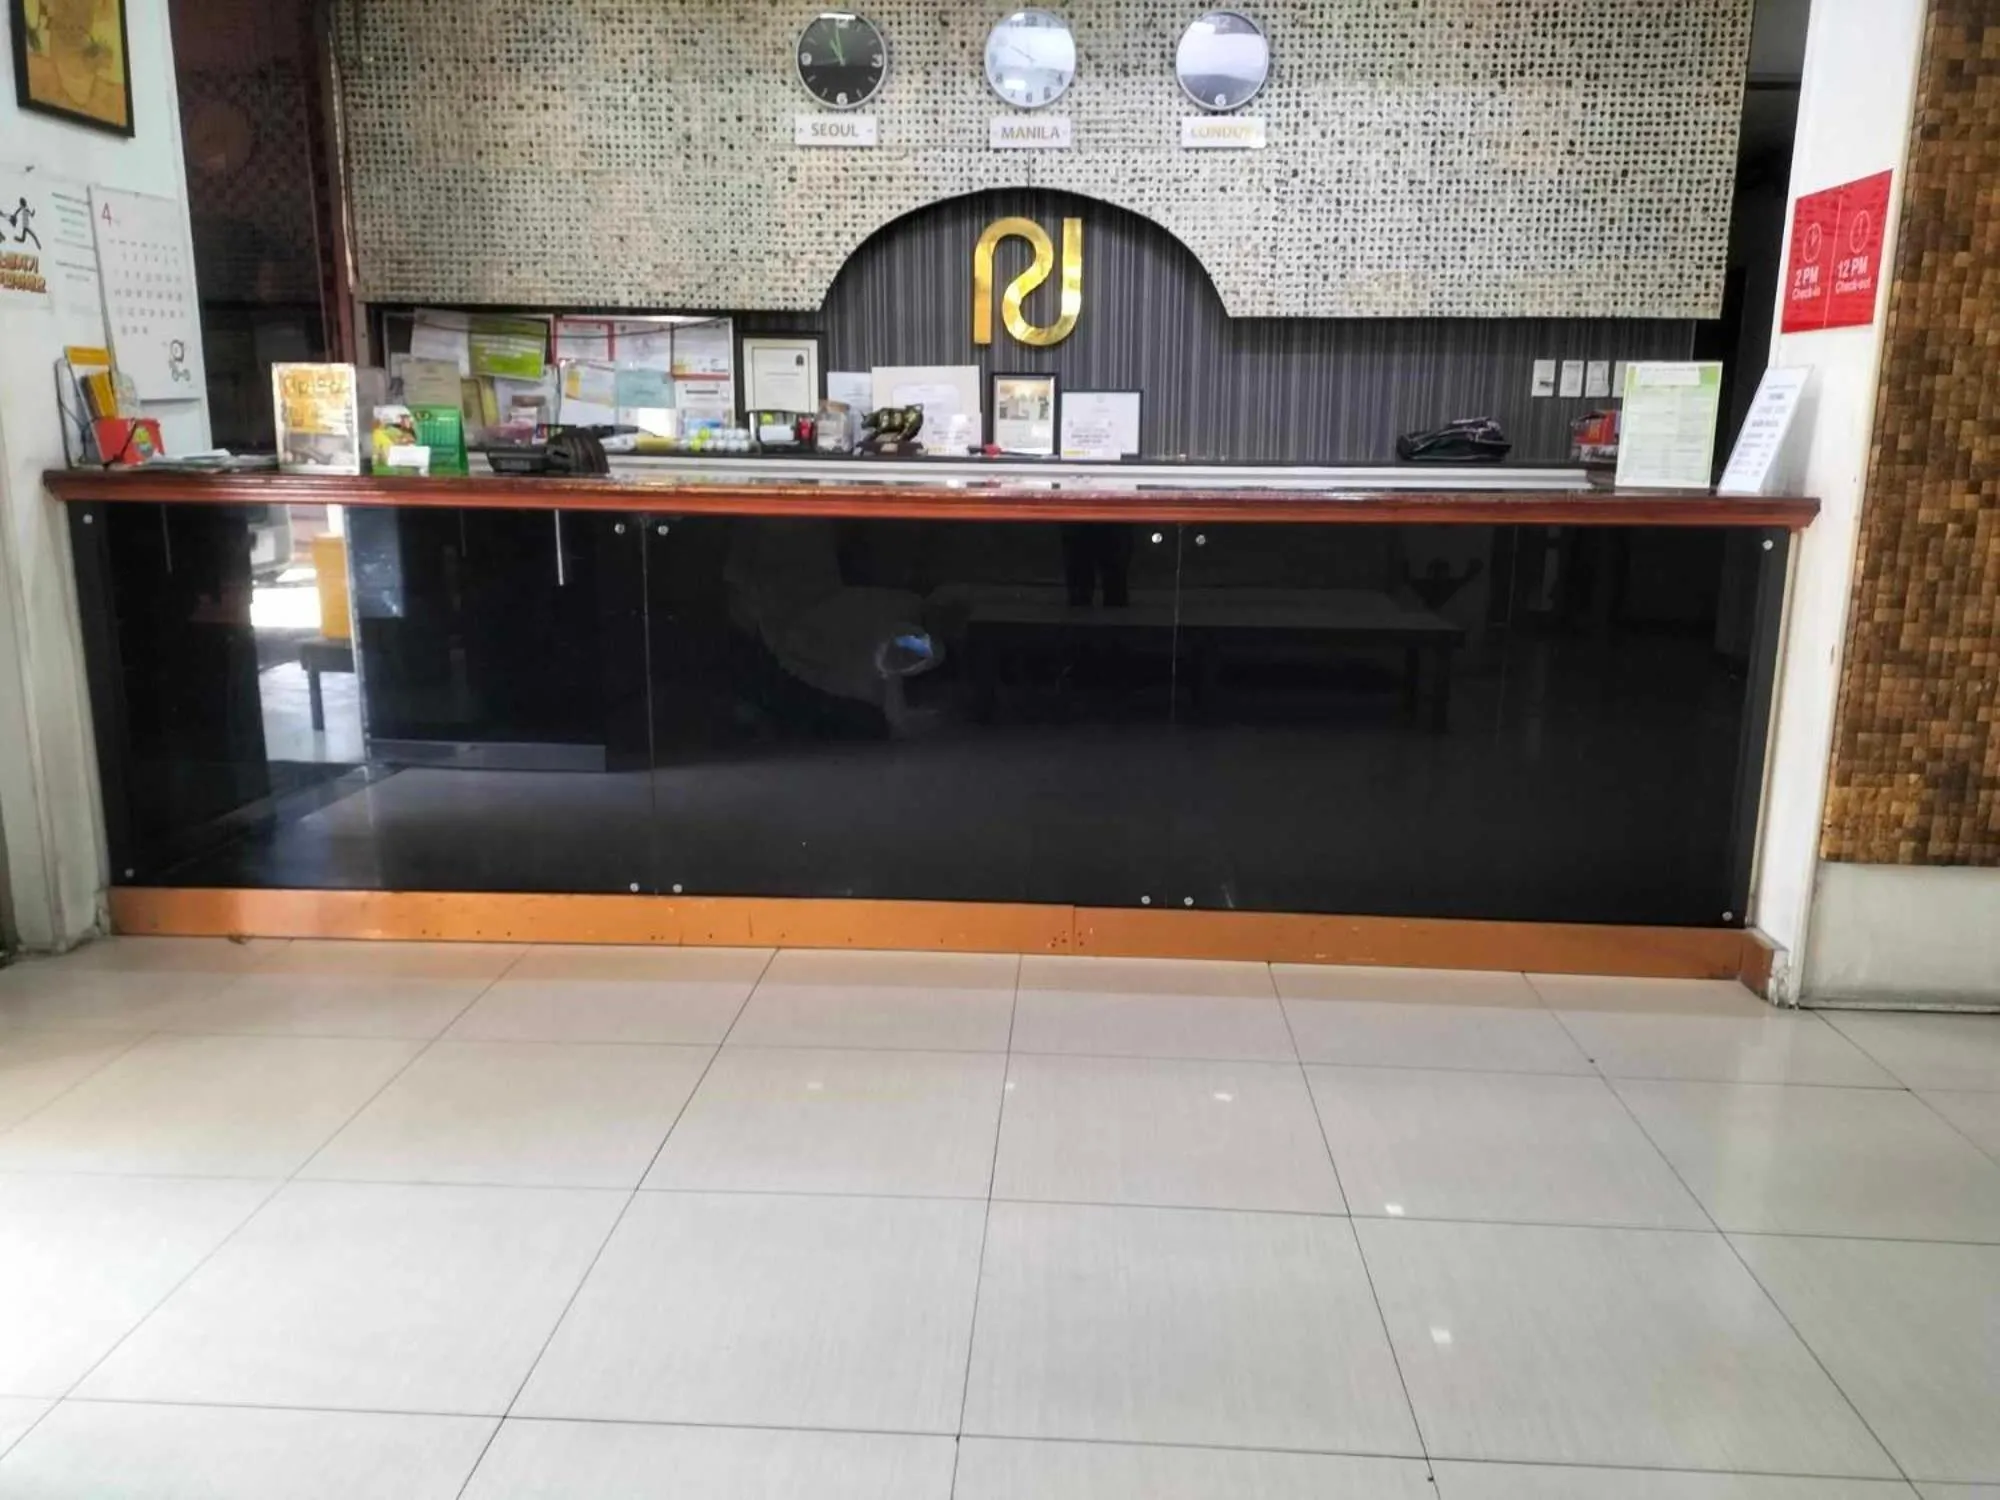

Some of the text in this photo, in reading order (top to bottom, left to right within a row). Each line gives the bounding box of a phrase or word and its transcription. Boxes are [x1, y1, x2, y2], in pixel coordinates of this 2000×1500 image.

[871, 53, 883, 68] 3
[835, 91, 848, 106] 6
[1214, 93, 1227, 107] 6
[811, 122, 859, 137] SEOUL
[1001, 126, 1061, 139] MANILA
[101, 202, 112, 226] 4
[1837, 256, 1869, 279] 12 PM
[1794, 266, 1820, 286] 2 PM
[1791, 285, 1821, 301] Check-in
